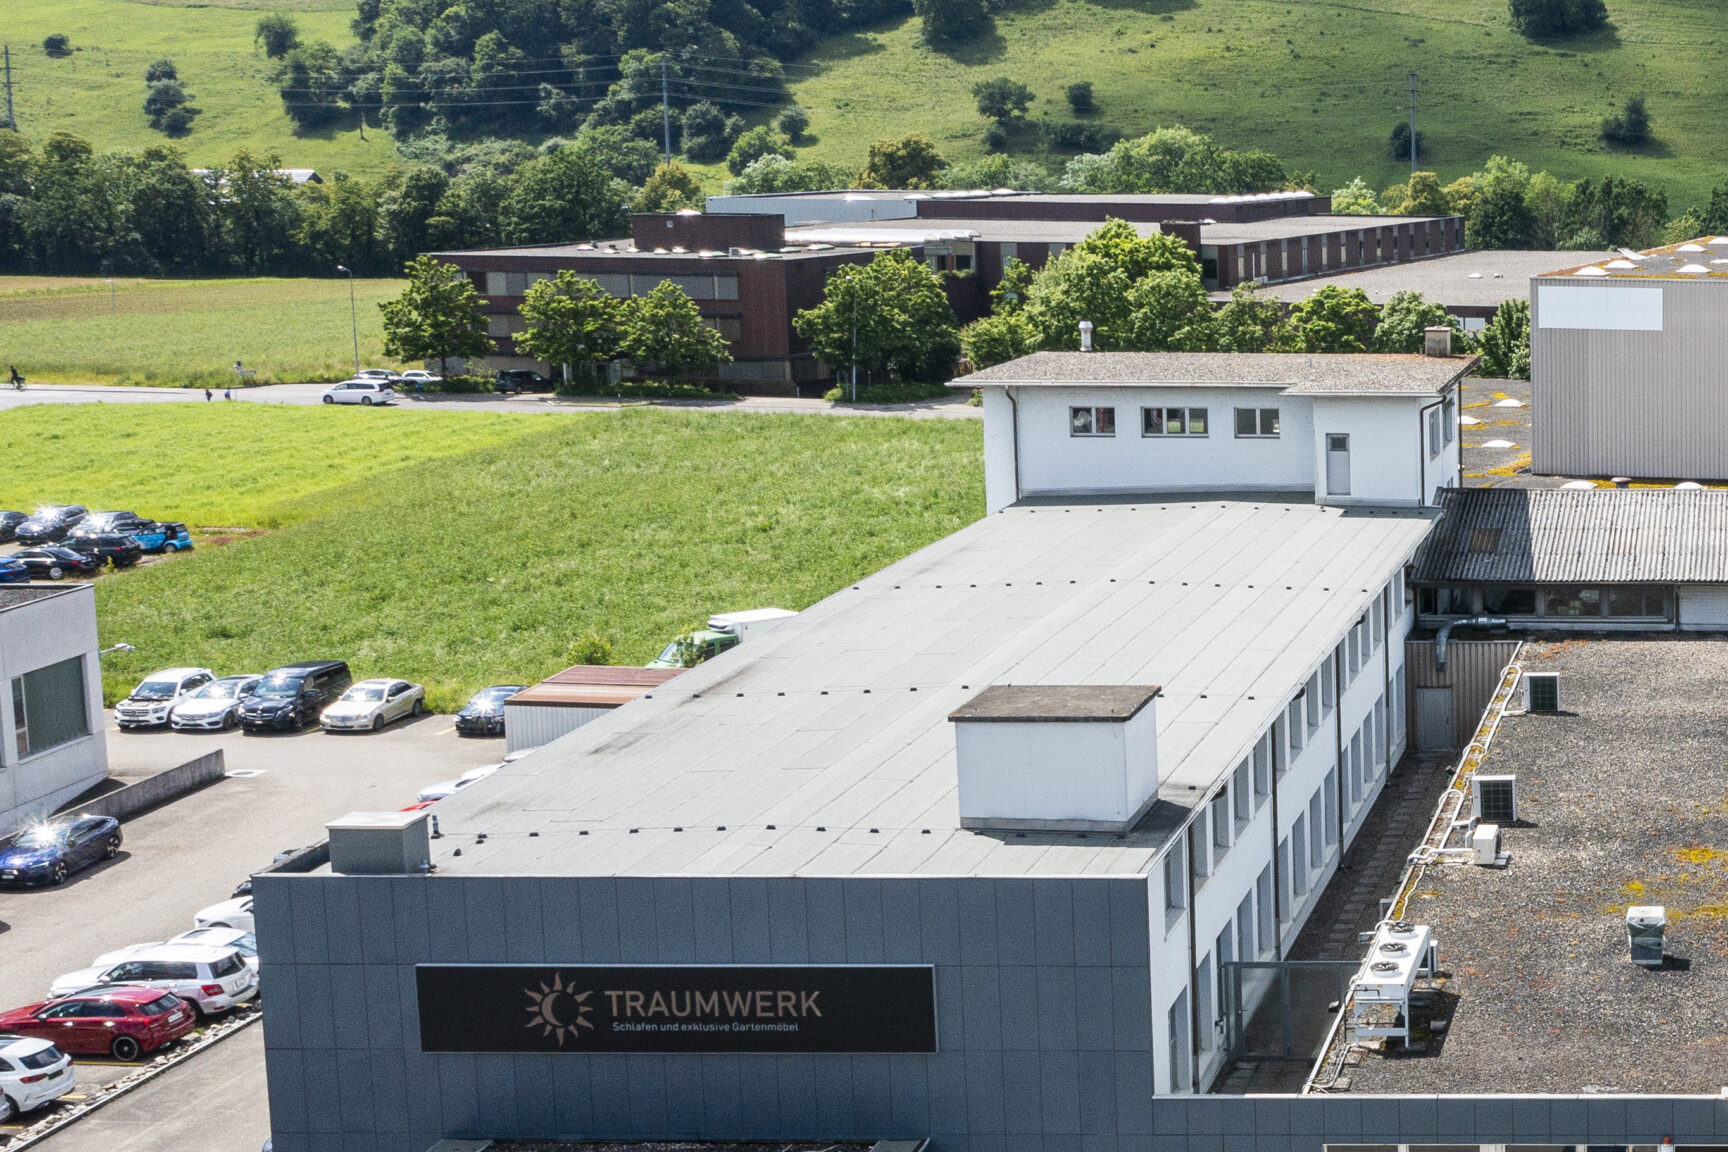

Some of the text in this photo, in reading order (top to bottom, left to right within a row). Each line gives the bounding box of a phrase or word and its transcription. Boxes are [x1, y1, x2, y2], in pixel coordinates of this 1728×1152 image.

[604, 990, 823, 1017] TRAUMWERK
[612, 1022, 799, 1032] Schlafen und exklusive Gartenmöbel
